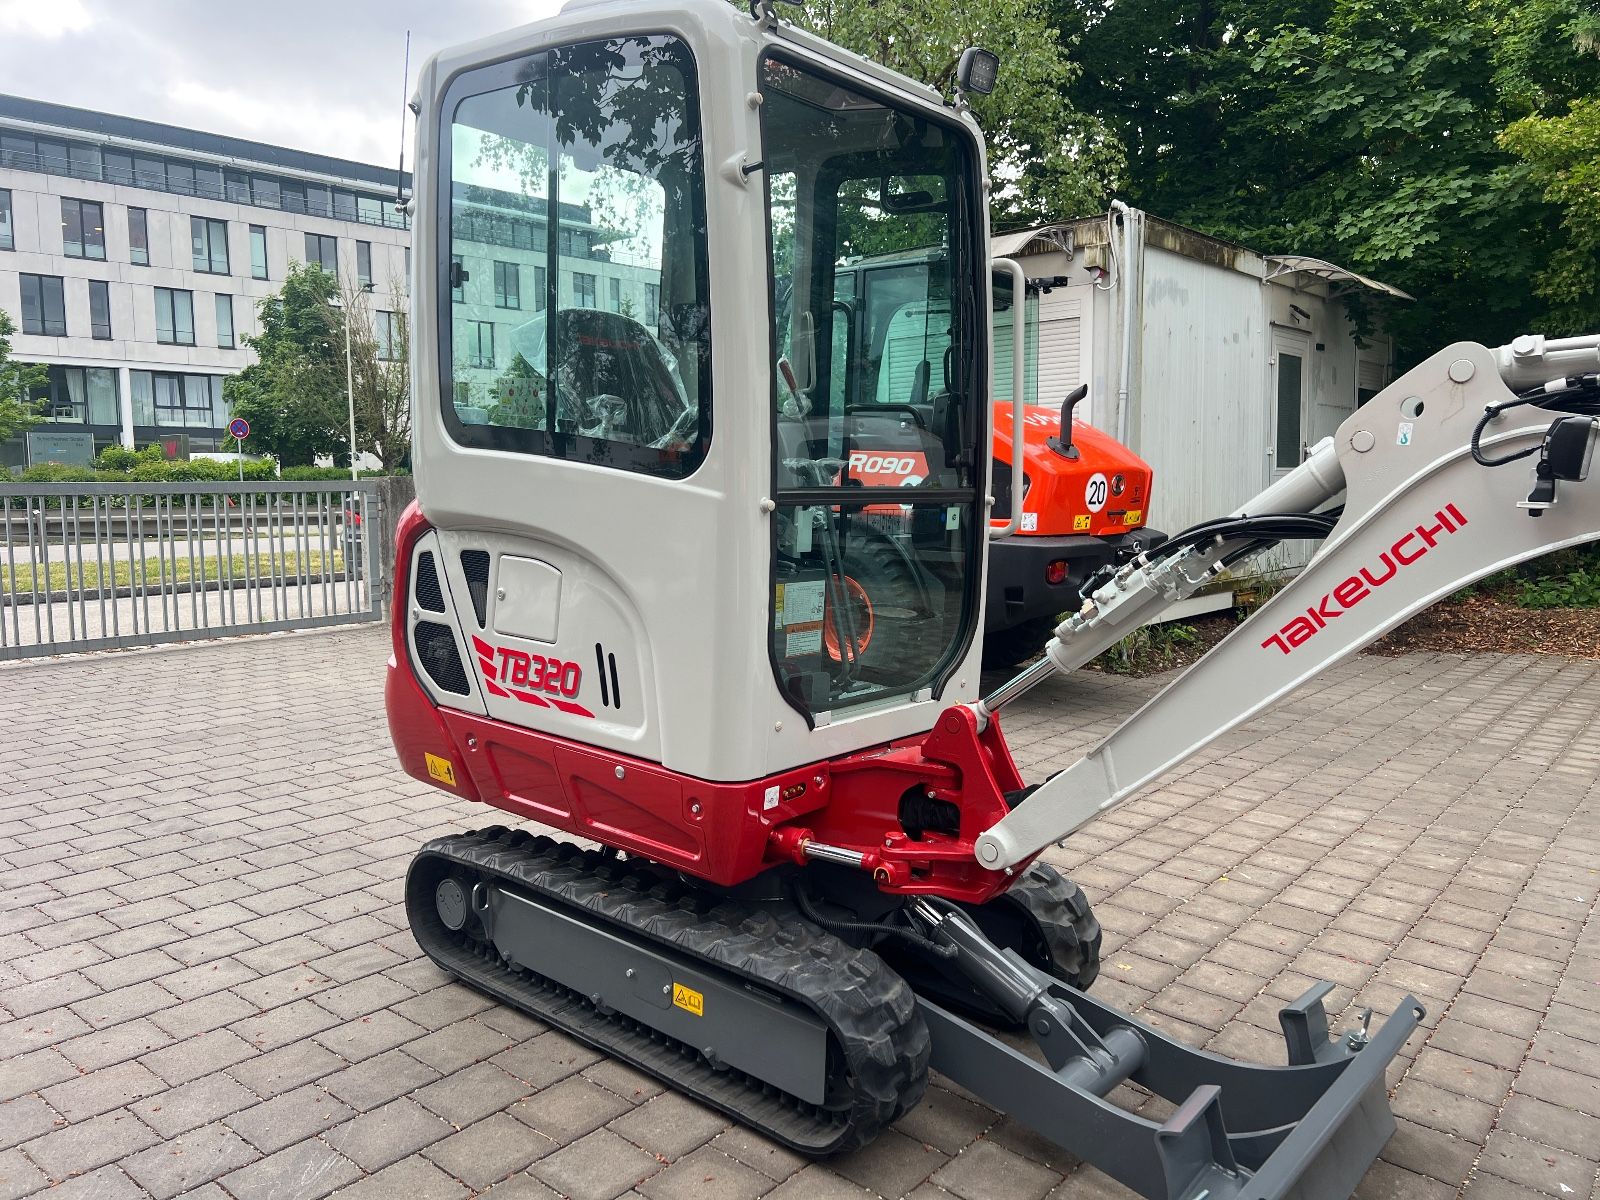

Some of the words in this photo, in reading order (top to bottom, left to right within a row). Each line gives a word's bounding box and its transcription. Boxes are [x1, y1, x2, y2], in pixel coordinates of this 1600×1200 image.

[849, 453, 915, 475] R090
[1088, 480, 1106, 505] 20
[496, 646, 582, 699] TB320
